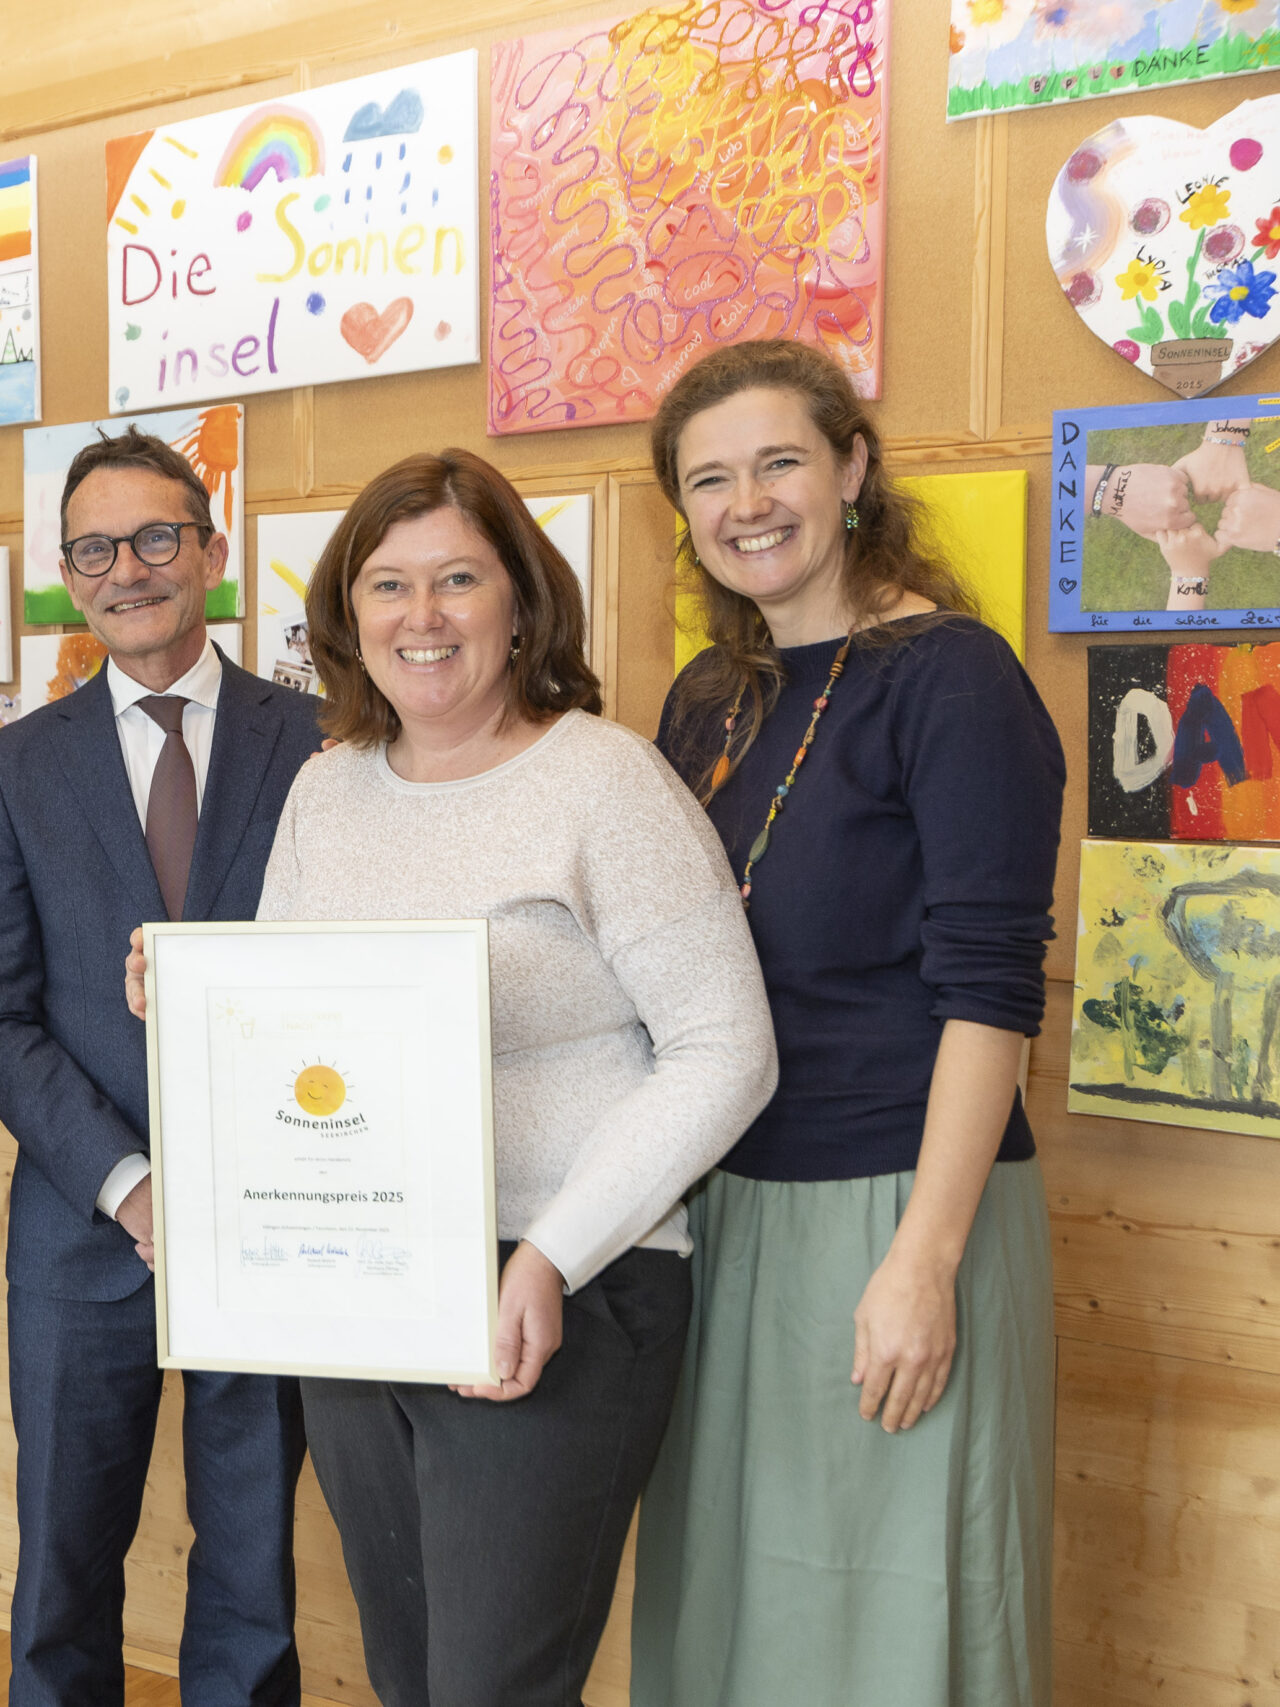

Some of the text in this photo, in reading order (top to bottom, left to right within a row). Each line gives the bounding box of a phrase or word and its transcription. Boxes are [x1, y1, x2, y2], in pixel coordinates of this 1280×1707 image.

[1135, 45, 1210, 77] DANKE
[1175, 175, 1230, 205] LEONIE
[123, 192, 465, 306] Die Sonnen
[1136, 245, 1173, 291] LYDIA
[684, 271, 714, 301] cool
[721, 300, 747, 328] toll
[158, 297, 280, 392] insel
[1159, 346, 1229, 360] SONNENINSEL
[1176, 380, 1204, 391] 2025
[1058, 421, 1081, 564] DANKE
[1091, 614, 1109, 626] für
[1133, 615, 1153, 626] die
[1175, 614, 1220, 625] schöne
[275, 1108, 367, 1130] Sonneninsel
[243, 1188, 405, 1205] Anerkennungspreis 2025
